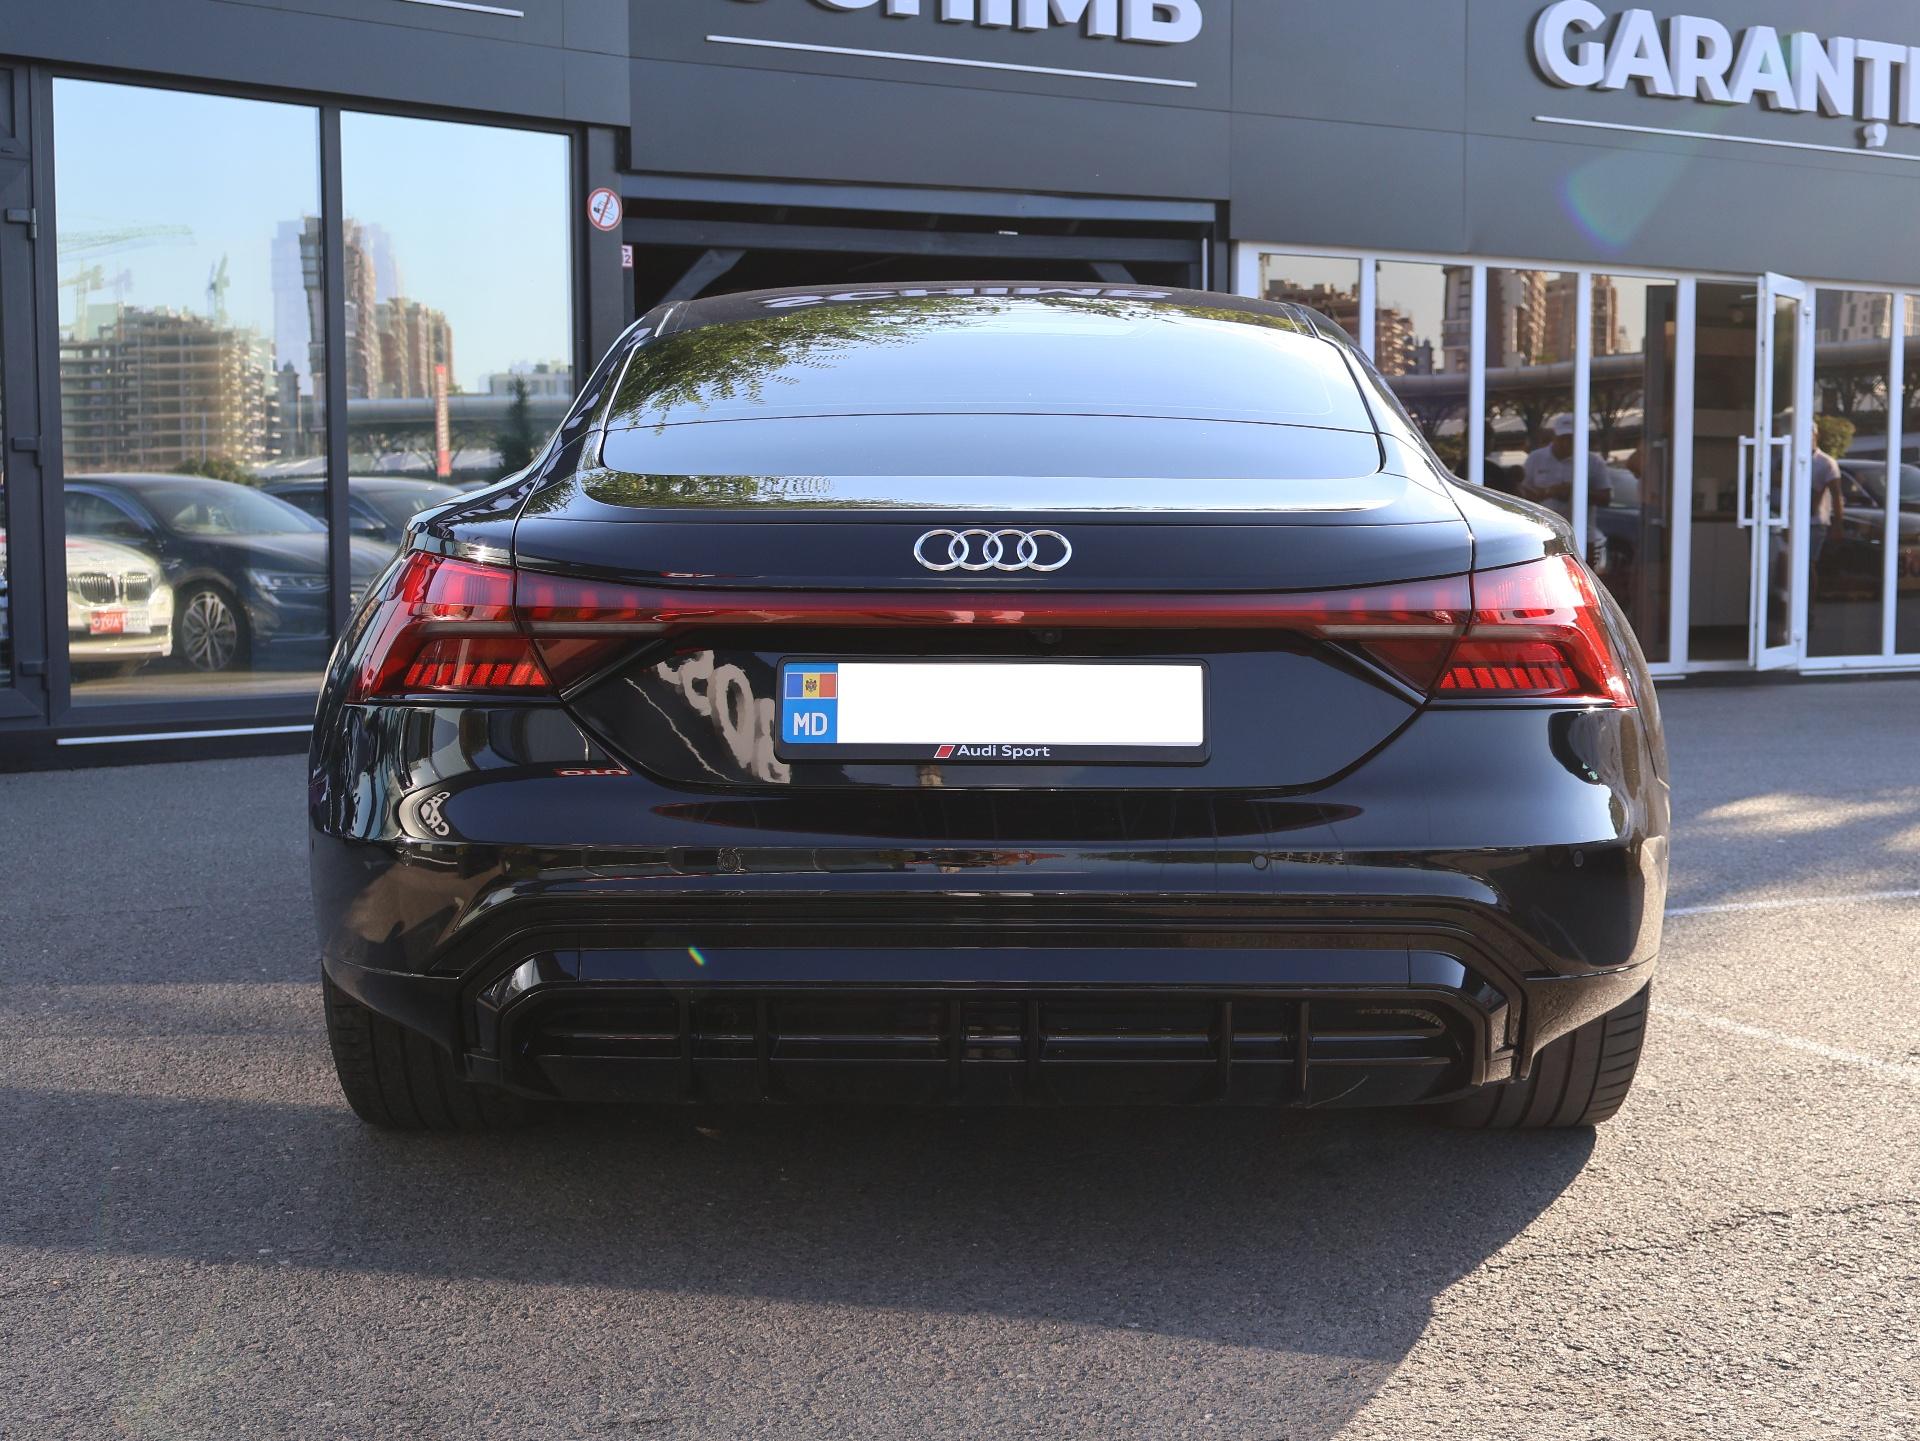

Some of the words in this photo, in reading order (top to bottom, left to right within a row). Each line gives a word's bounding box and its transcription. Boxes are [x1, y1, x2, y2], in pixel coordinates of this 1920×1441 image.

[793, 712, 828, 736] MD
[957, 744, 997, 757] Audi
[1001, 744, 1050, 759] Sport
